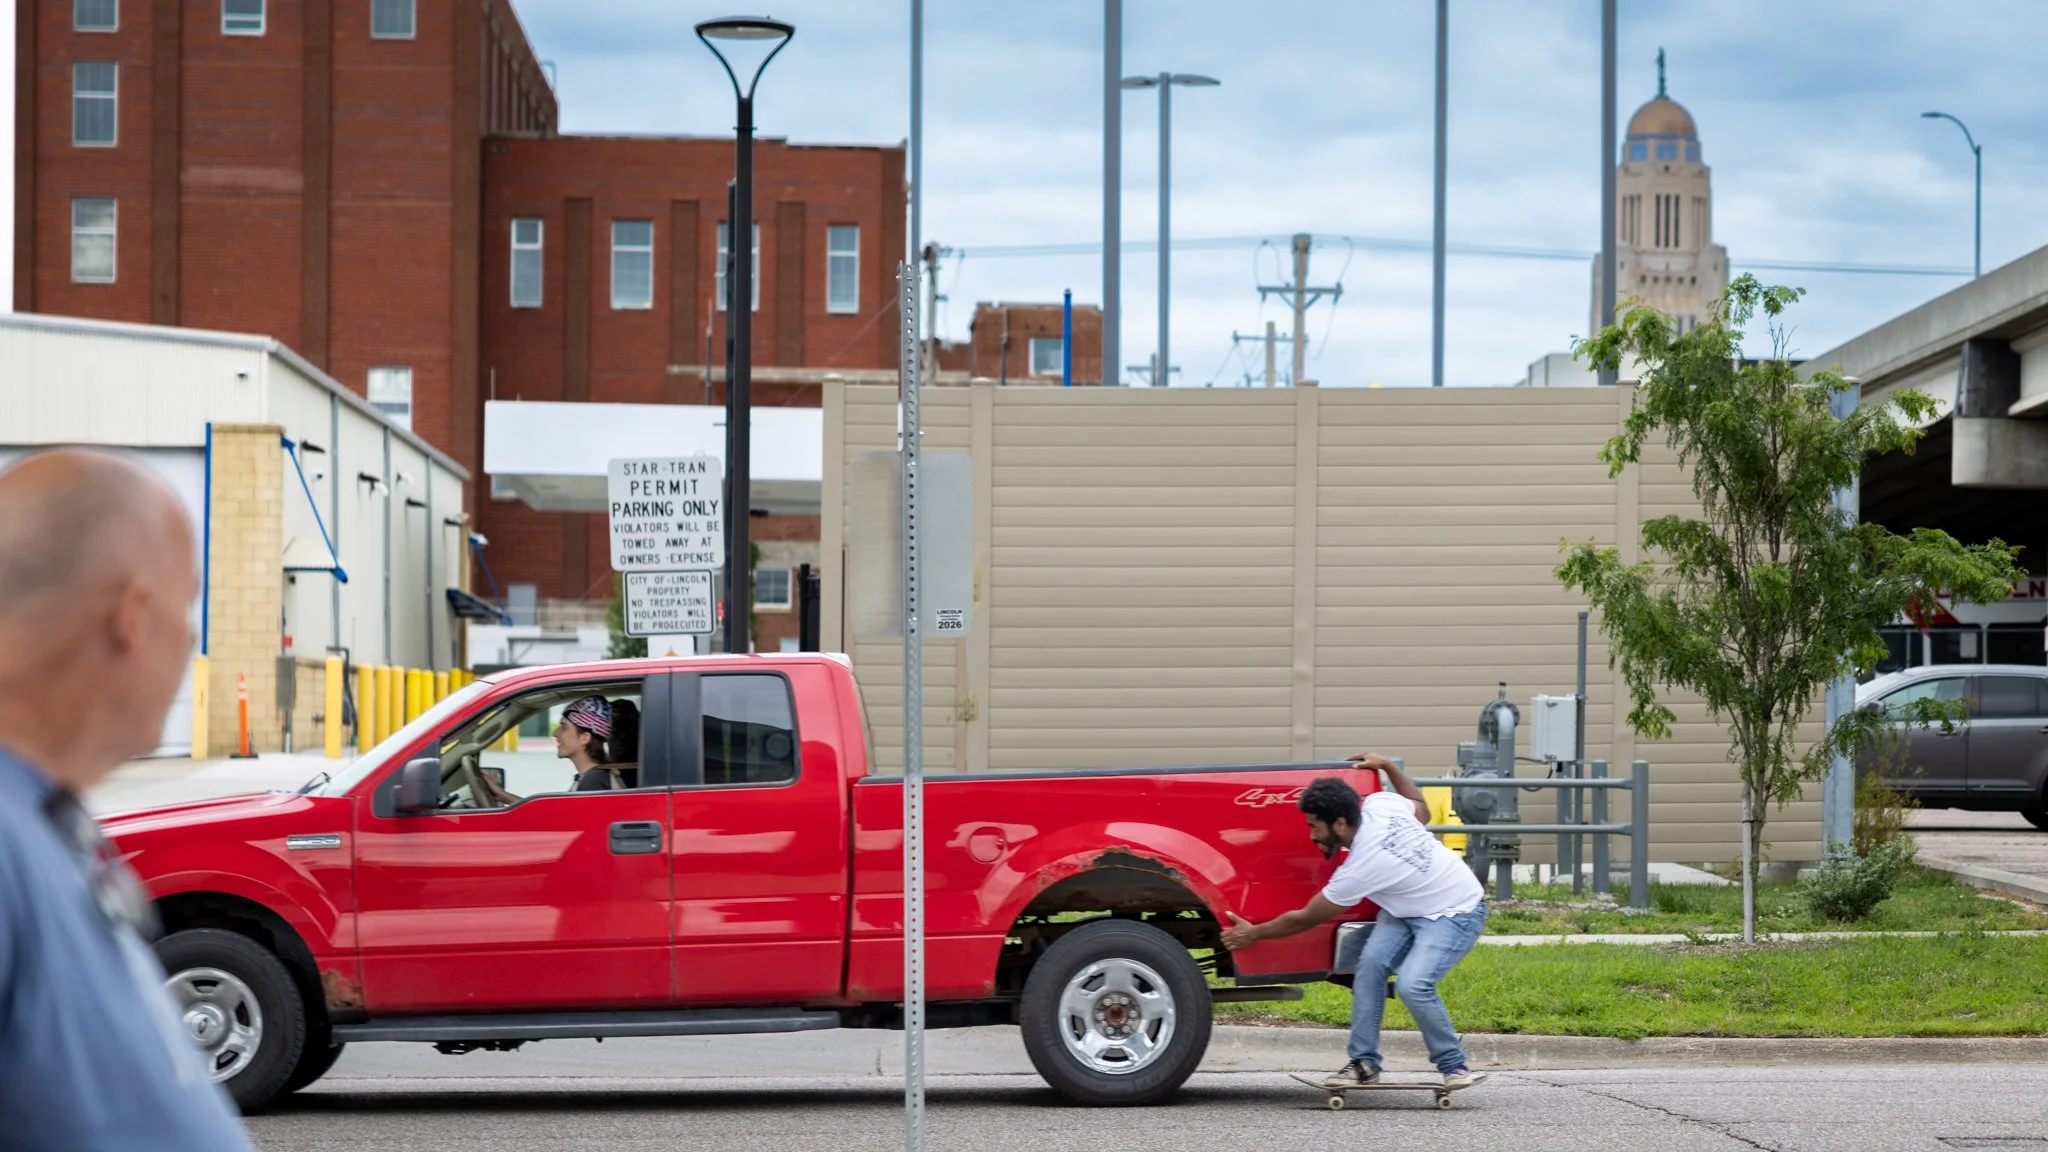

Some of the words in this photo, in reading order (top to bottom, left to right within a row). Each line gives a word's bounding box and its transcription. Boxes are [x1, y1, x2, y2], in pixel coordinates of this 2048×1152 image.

[623, 462, 658, 476] STAR
[669, 461, 706, 475] TRAN
[630, 479, 698, 496] PERMIT
[612, 501, 674, 518] PARKING
[682, 500, 718, 516] ONLY
[613, 522, 669, 534] VIOLATORS
[676, 521, 700, 532] WILL
[707, 521, 719, 532] BE
[622, 538, 655, 549] TOWED
[665, 537, 689, 548] AWAY
[701, 537, 711, 547] AT
[620, 554, 660, 566] OWNERS
[670, 552, 715, 564] EXPENSE
[630, 576, 647, 585] CITY
[654, 576, 665, 584] OF
[672, 575, 707, 584] LINCOLN
[647, 587, 690, 596] PROPERTY
[631, 599, 643, 608] NO
[650, 598, 707, 607] TRESPASSING
[633, 610, 678, 619] VIOLATORS
[687, 609, 706, 618] WILL
[633, 621, 644, 631] BE
[652, 620, 706, 629] PROSECUTED
[938, 620, 962, 629] 2026
